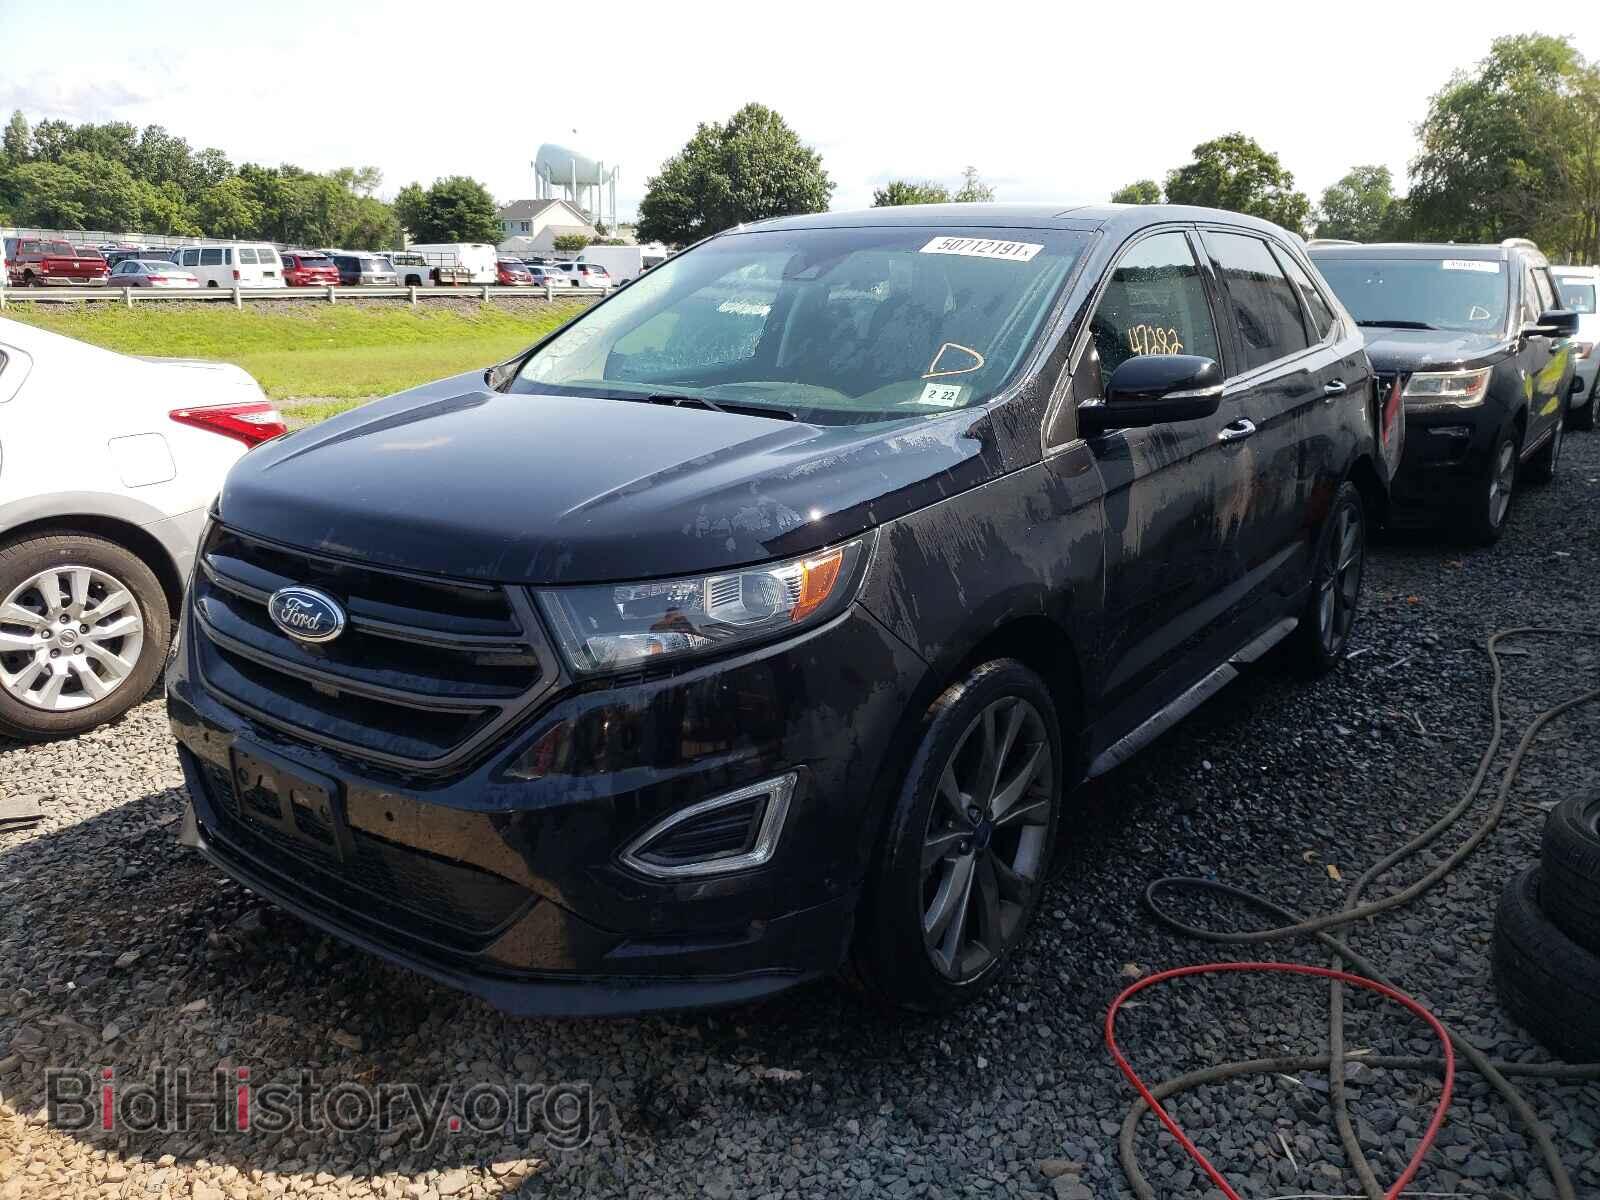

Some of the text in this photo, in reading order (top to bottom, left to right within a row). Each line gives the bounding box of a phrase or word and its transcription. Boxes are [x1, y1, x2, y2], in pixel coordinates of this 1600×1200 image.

[928, 390, 955, 401] 2 22
[281, 597, 323, 630] Ford
